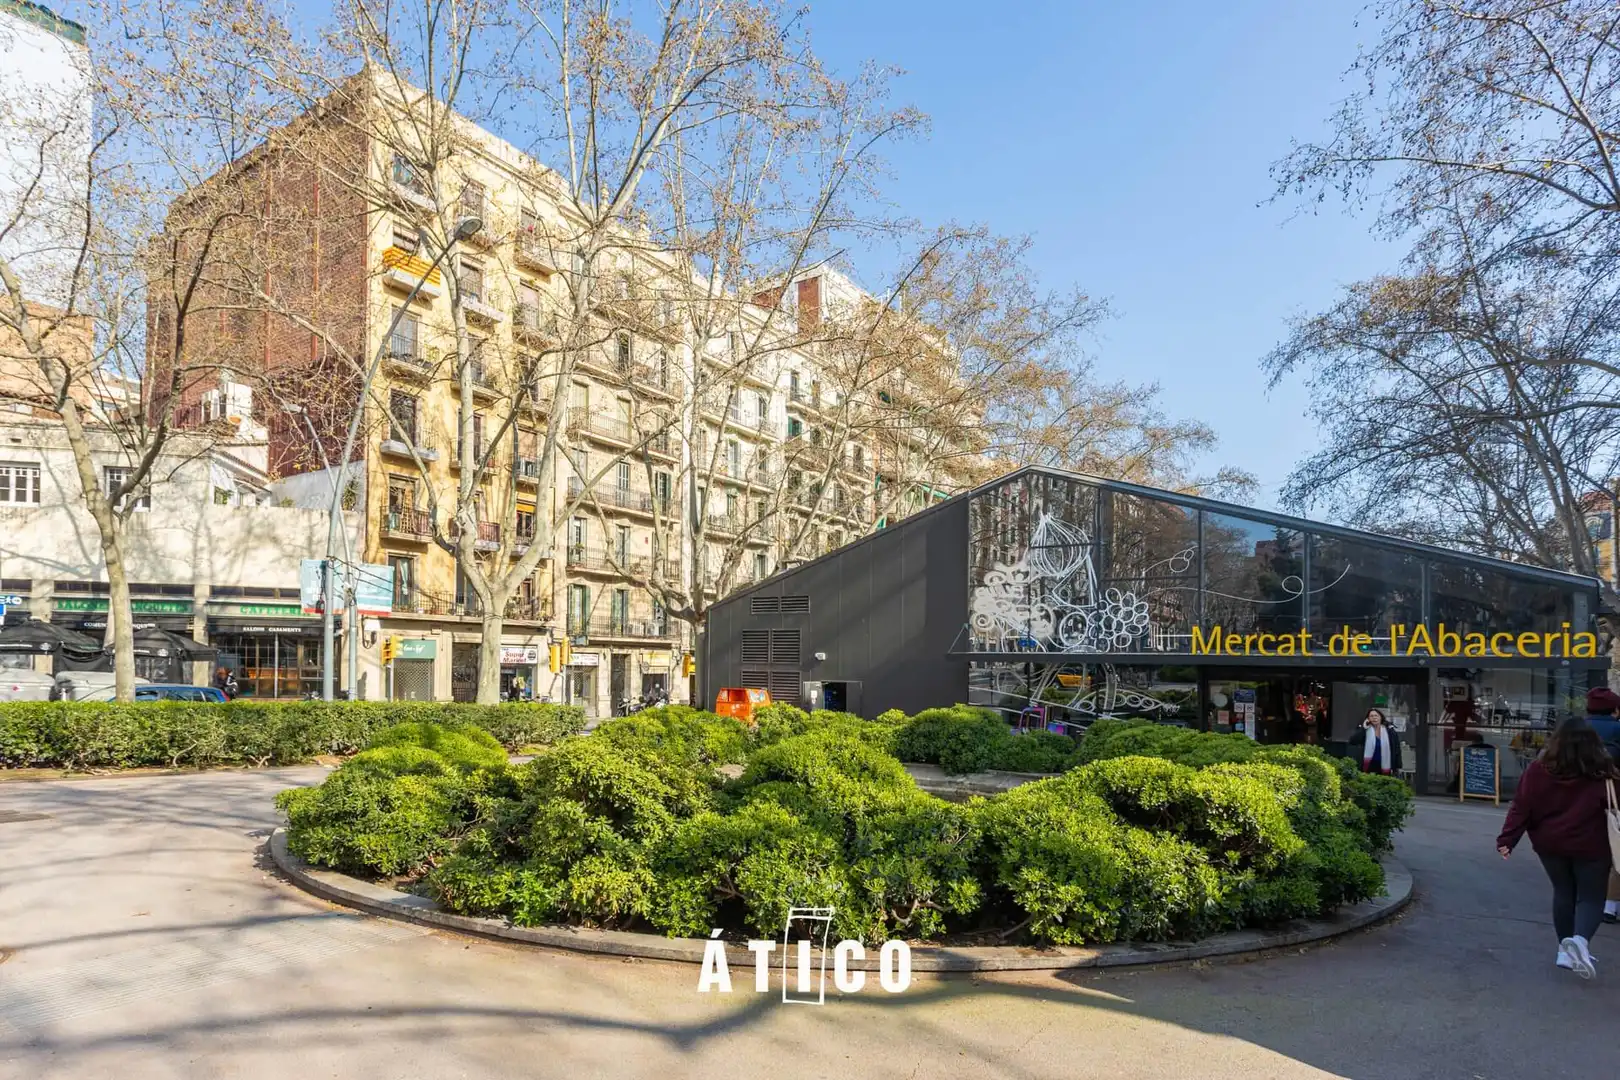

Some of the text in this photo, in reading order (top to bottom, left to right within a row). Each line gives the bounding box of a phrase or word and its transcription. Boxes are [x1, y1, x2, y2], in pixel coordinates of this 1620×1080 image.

[1191, 622, 1598, 657] Mercat de l'Abaceria
